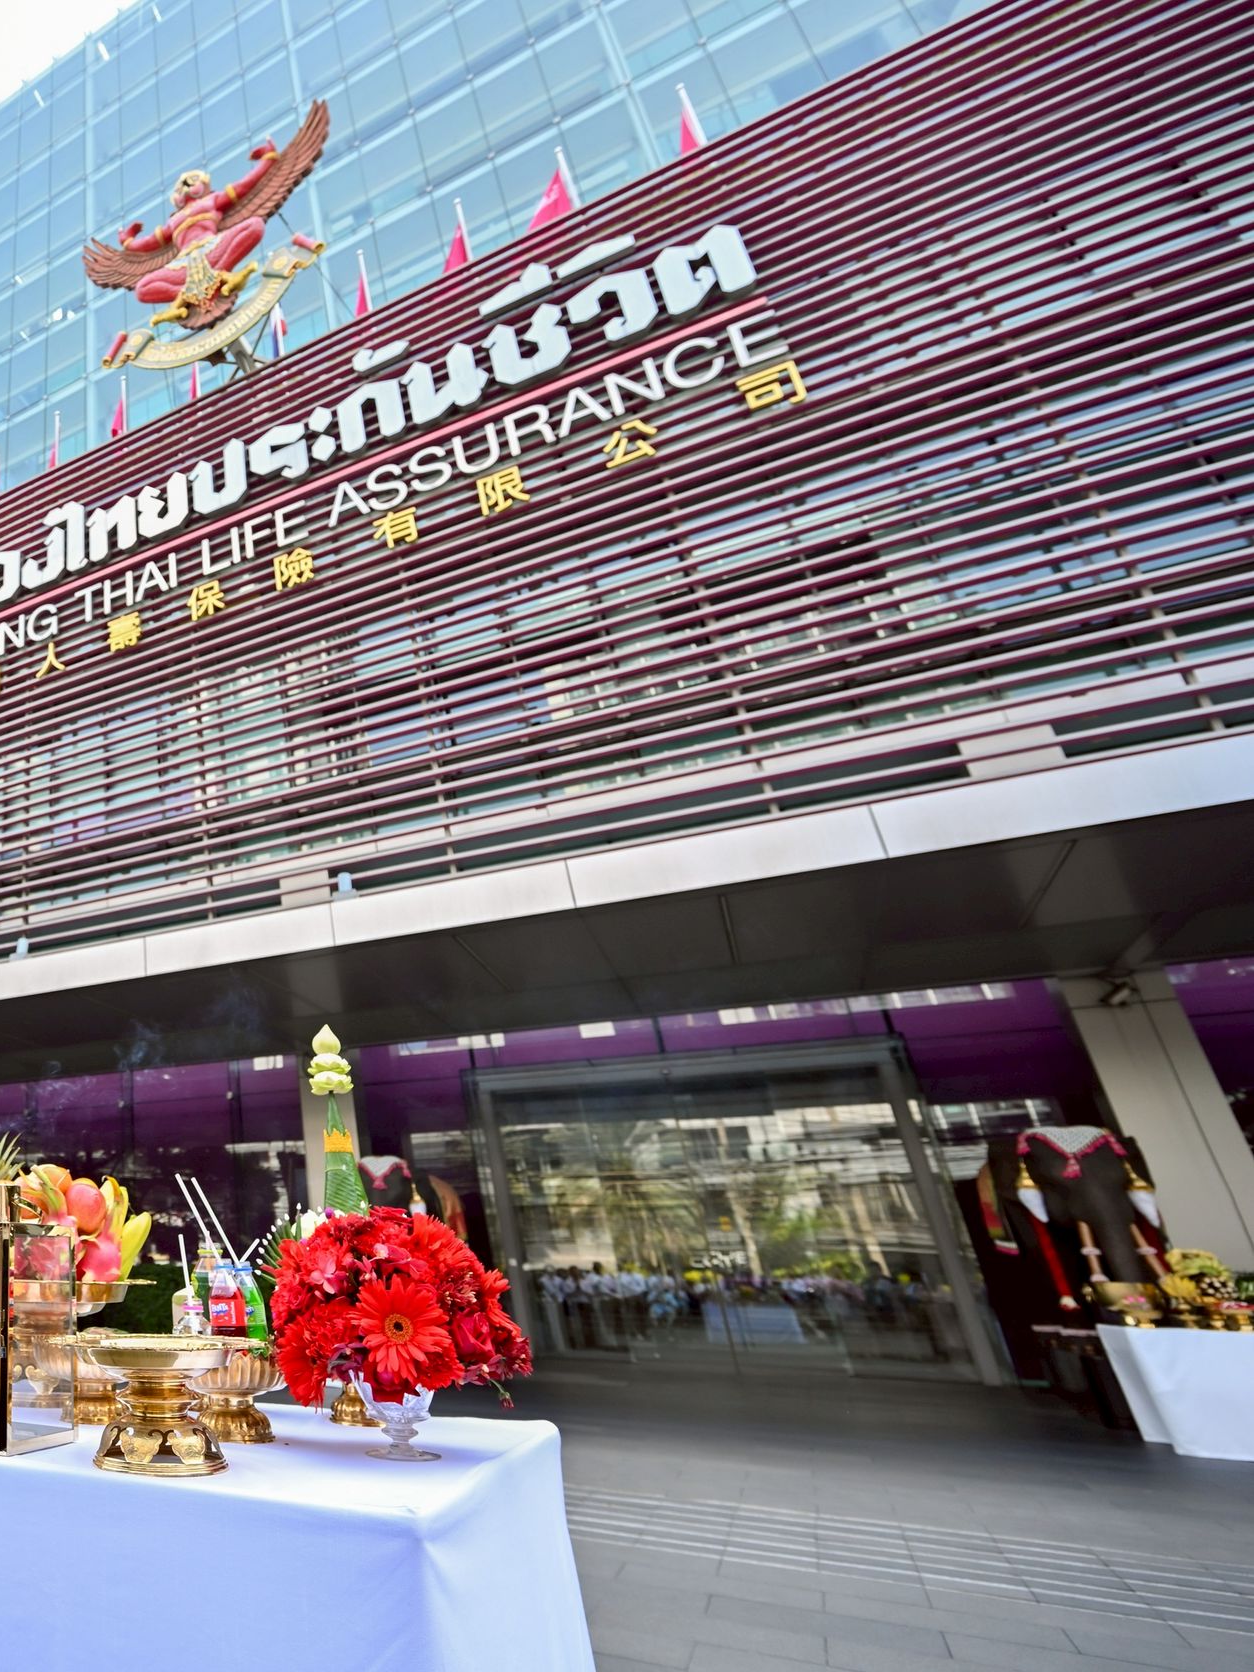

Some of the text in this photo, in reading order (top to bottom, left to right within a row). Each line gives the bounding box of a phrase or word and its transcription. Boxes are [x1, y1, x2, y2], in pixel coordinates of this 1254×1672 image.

[74, 552, 178, 622] THAI
[201, 500, 309, 576] LIFE
[329, 309, 790, 528] ASSURANCE
